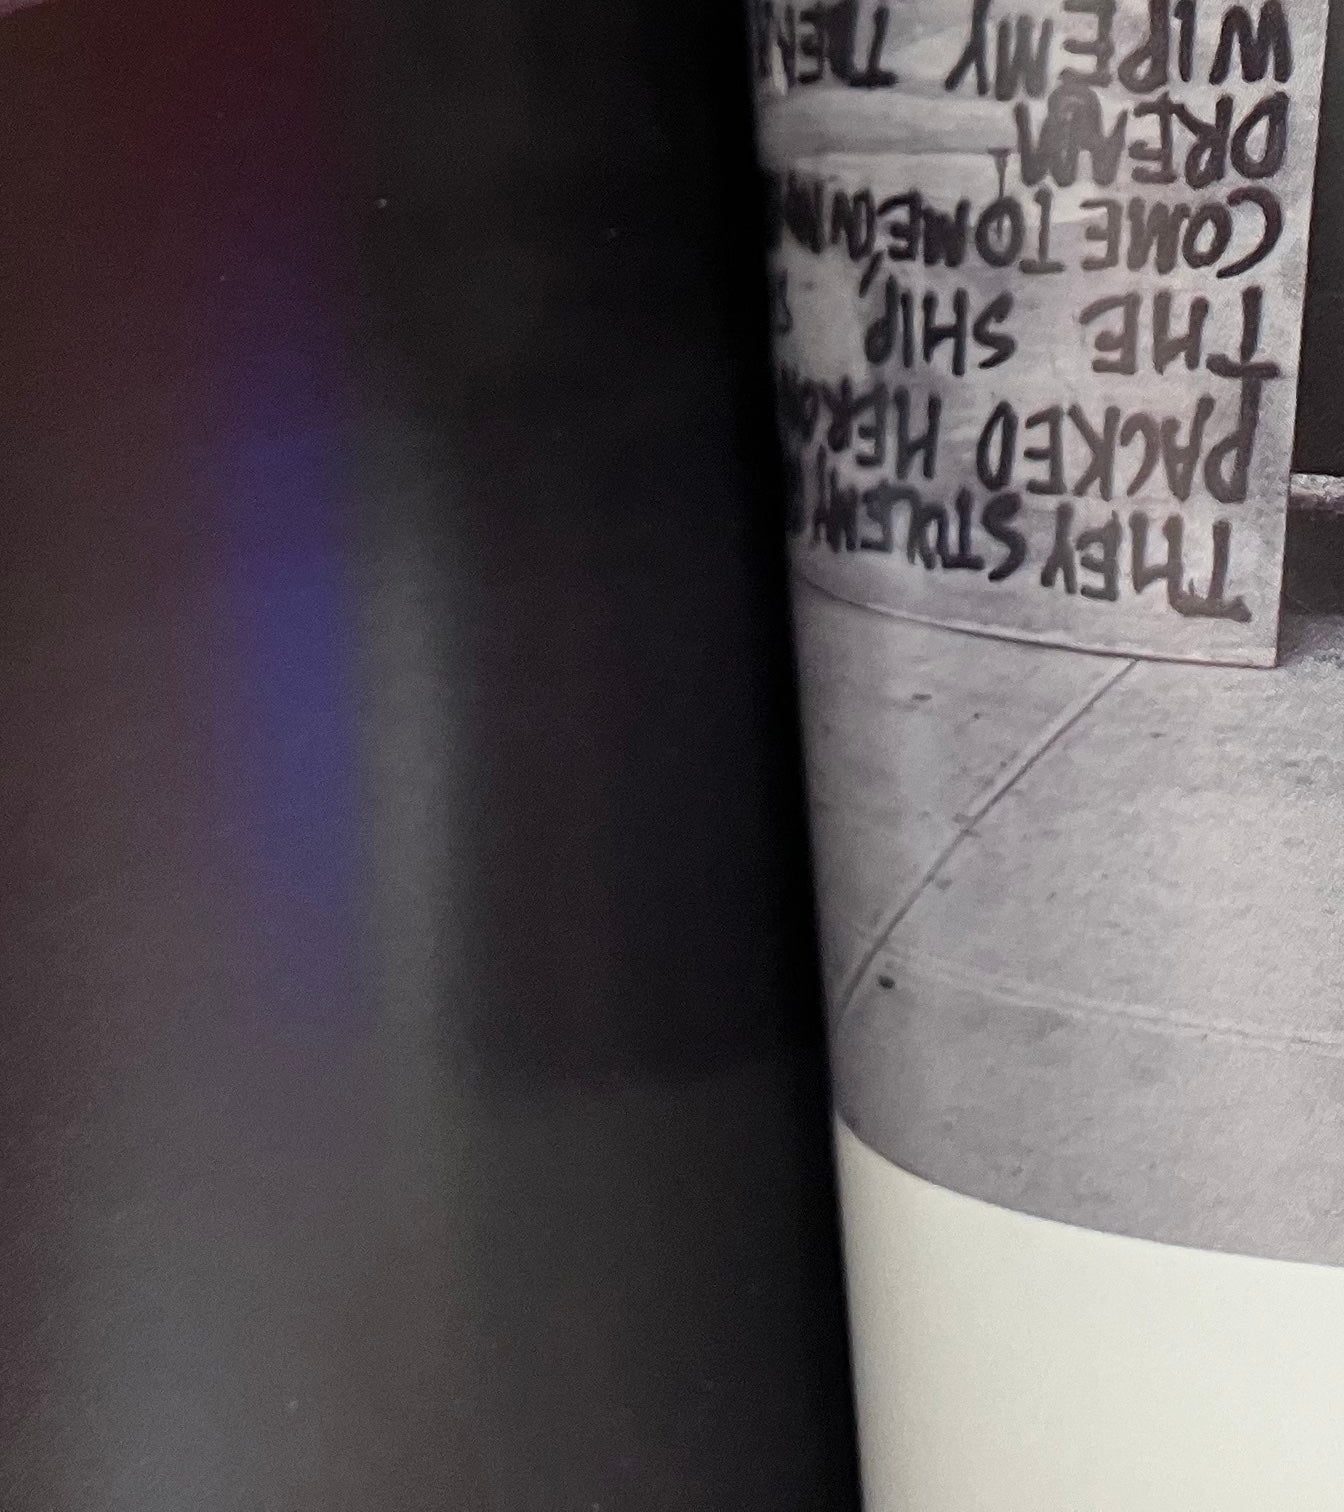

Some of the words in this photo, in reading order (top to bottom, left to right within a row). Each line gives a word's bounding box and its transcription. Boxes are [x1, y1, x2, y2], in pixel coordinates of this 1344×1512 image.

[1014, 85, 1293, 190] DREAM
[973, 188, 1065, 274] TO
[1081, 186, 1284, 278] COME
[1080, 286, 1280, 378] THE
[822, 378, 941, 482] HER
[974, 378, 1264, 504] PACKED
[1041, 501, 1251, 623] THEY
